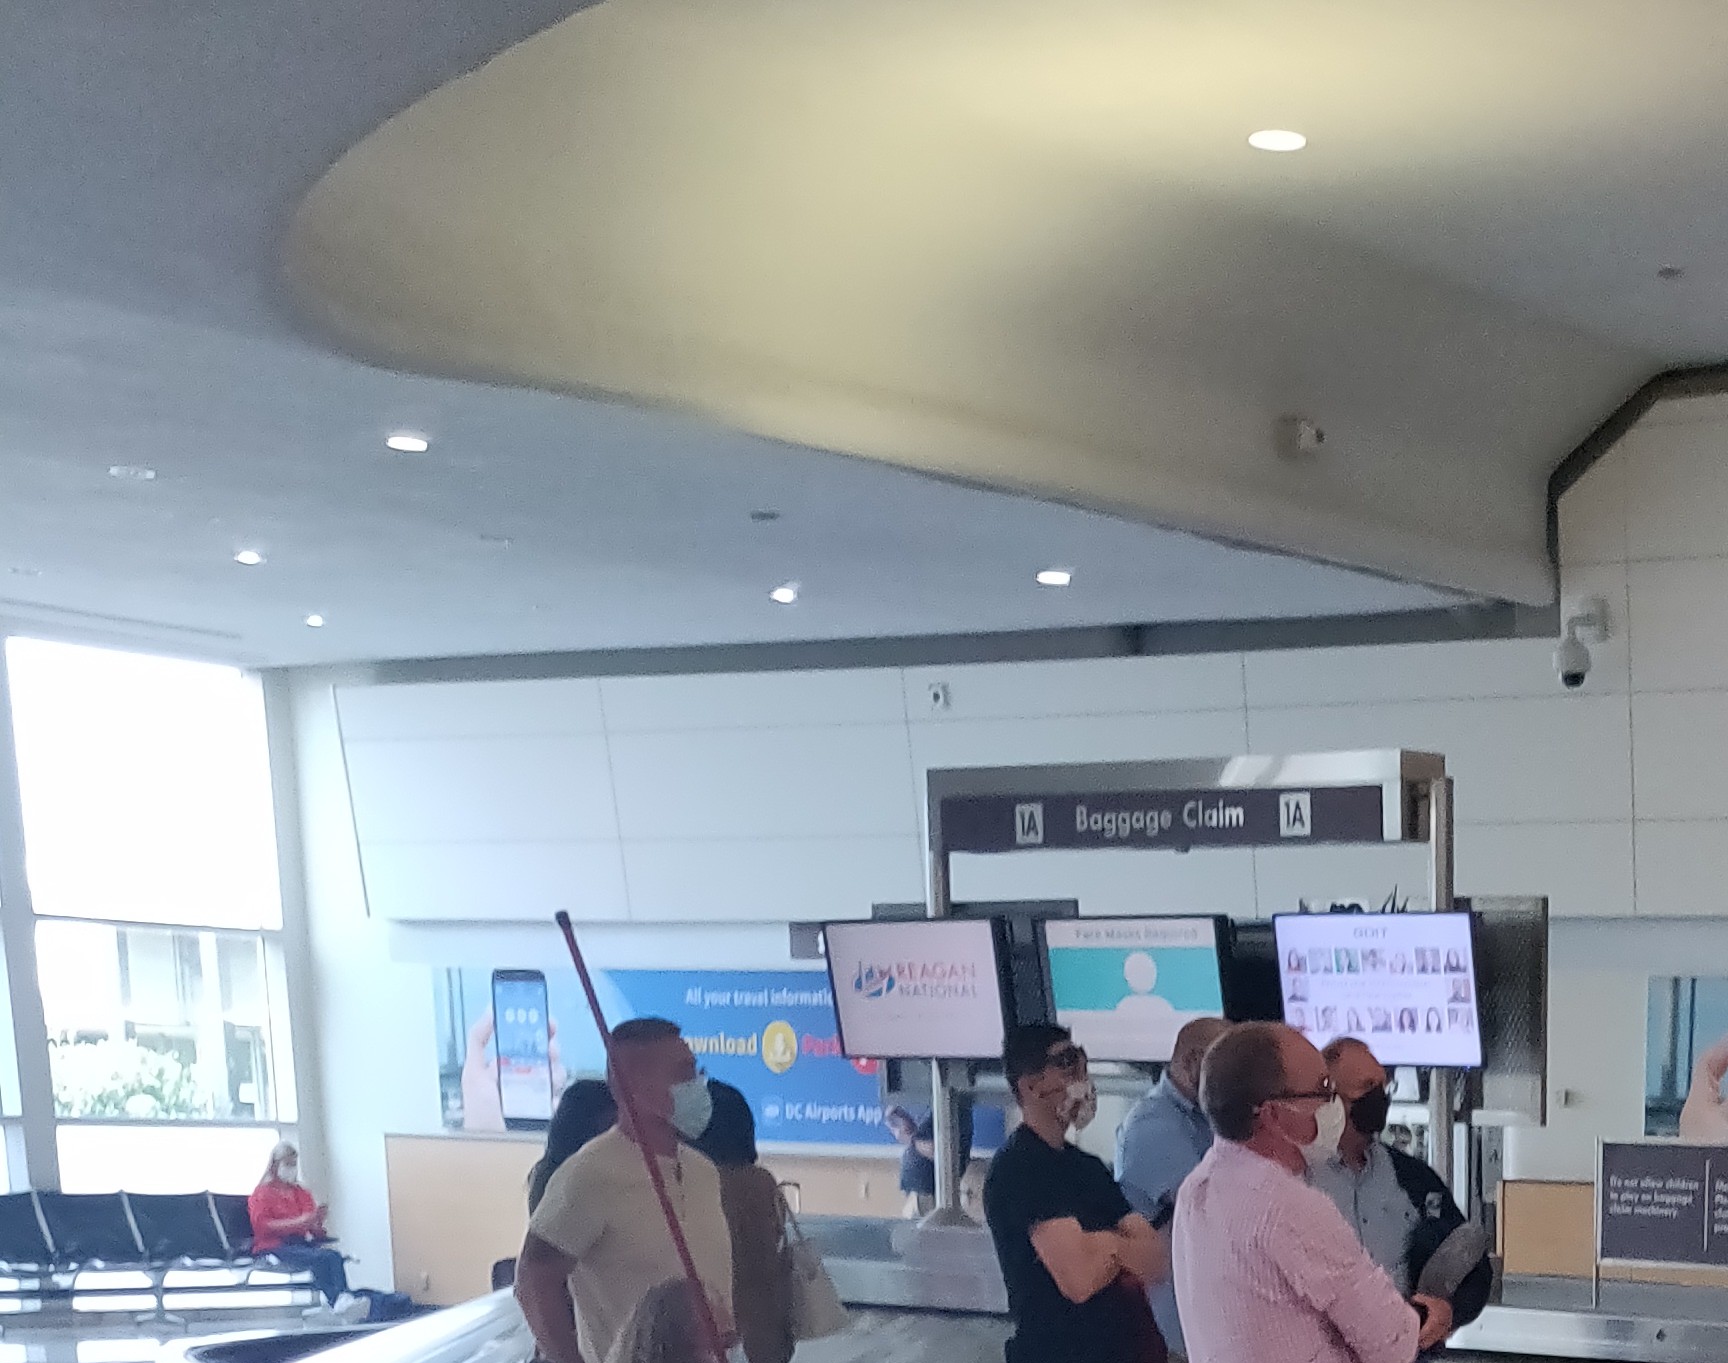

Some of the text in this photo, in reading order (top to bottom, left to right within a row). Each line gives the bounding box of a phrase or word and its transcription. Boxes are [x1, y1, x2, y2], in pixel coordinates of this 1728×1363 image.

[1020, 799, 1306, 838] 1A Baggage Claim 1A
[895, 961, 977, 982] REAGAN
[686, 986, 702, 1005] All
[704, 989, 731, 1009] your
[733, 987, 769, 1007] travel
[900, 983, 977, 999] NATIONAL
[683, 1031, 758, 1057] ownload
[785, 1102, 883, 1128] DC Airports App
